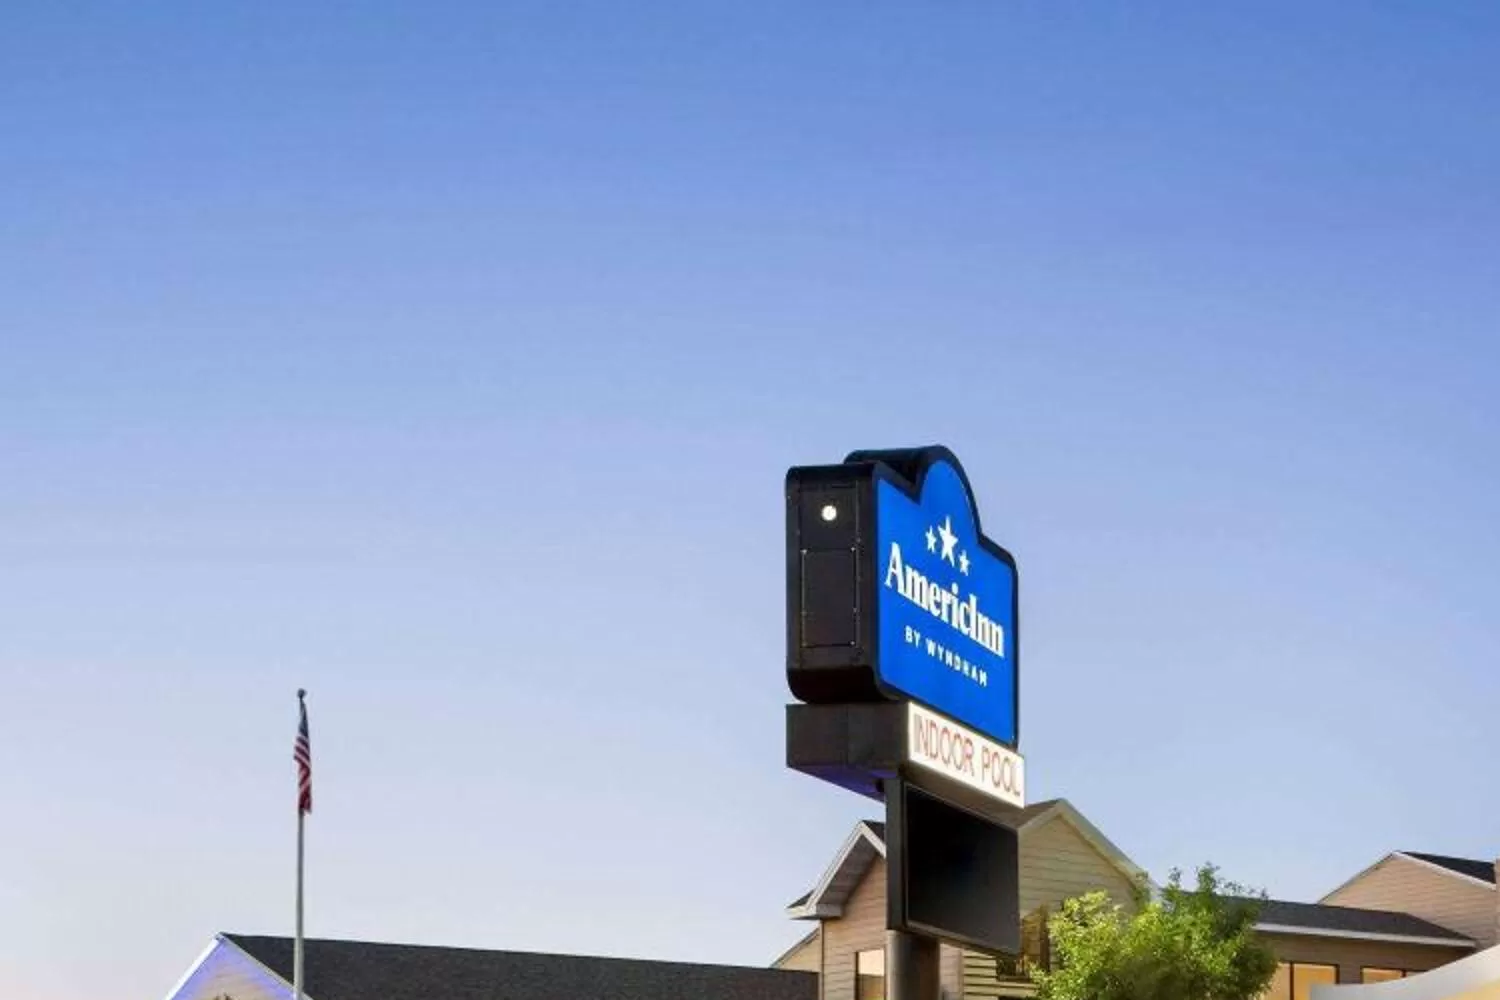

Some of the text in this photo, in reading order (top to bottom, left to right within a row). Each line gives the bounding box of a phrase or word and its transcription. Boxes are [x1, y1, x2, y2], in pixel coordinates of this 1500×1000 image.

[884, 541, 1005, 659] AmericInn
[905, 624, 921, 648] BY
[913, 712, 1022, 797] INDOOR POOL
